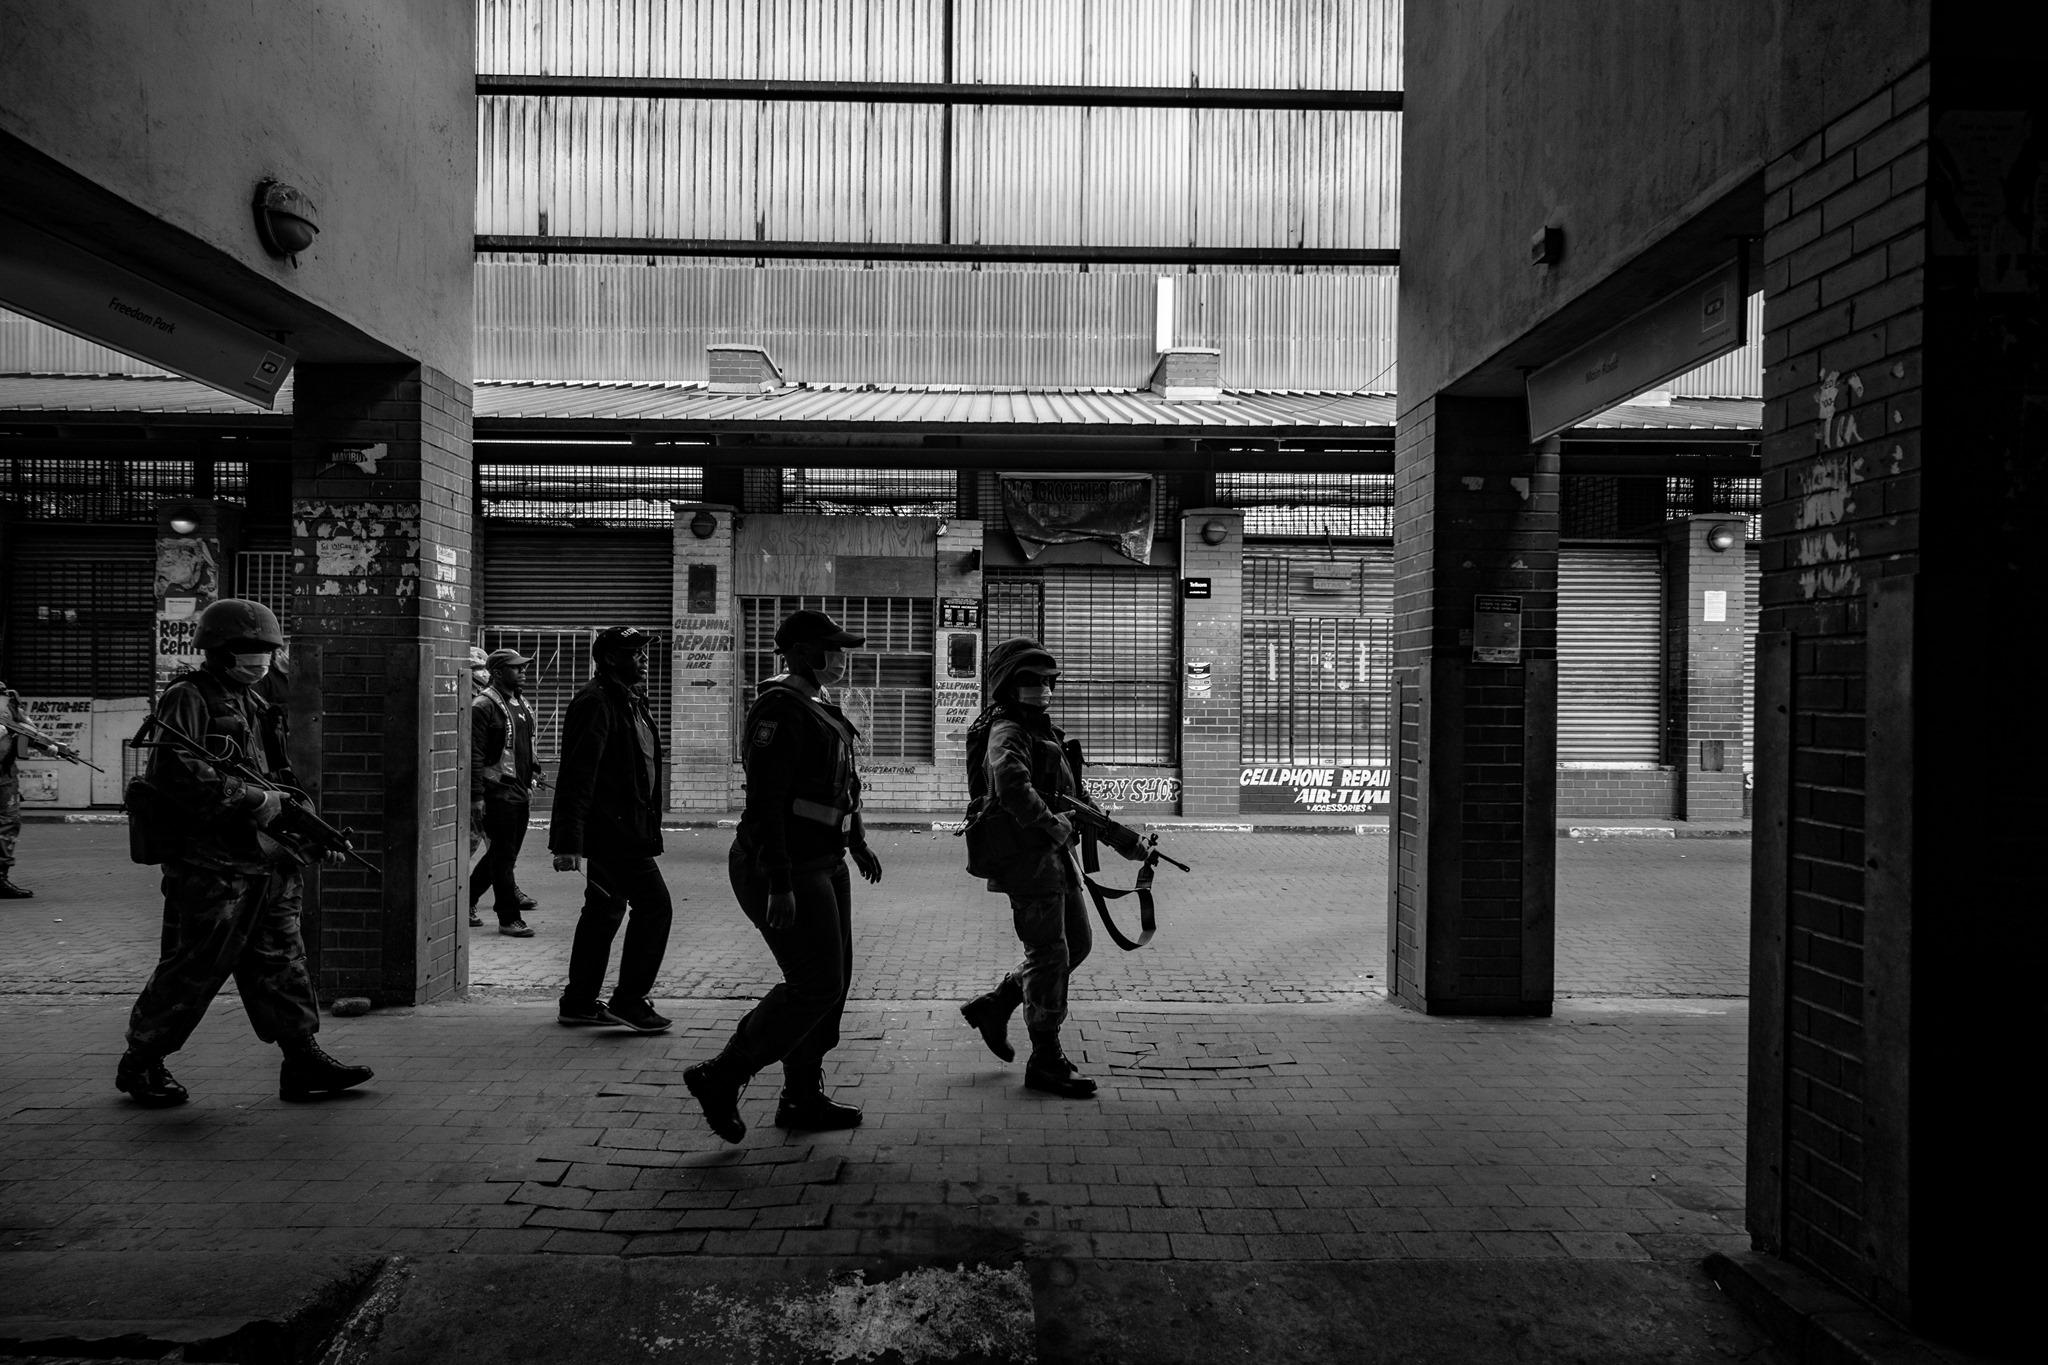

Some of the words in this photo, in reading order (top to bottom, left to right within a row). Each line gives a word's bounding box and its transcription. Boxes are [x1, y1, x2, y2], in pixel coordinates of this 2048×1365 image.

[108, 297, 153, 324] Freedom
[152, 316, 175, 334] Park
[1037, 481, 1107, 503] GROCERIES
[1108, 481, 1142, 503] SHOP
[160, 621, 199, 641] Repa
[674, 619, 730, 630] CELLPHONE
[687, 653, 714, 661] DONE
[686, 661, 712, 669] HERE
[936, 682, 981, 690] CELLPHONE
[936, 692, 979, 707] REPAIR
[30, 701, 91, 713] PASTOR-BEE
[1239, 768, 1335, 787] CELLPHONE
[1129, 777, 1183, 804] SHOP
[1310, 804, 1367, 812] ACCESSORIES
